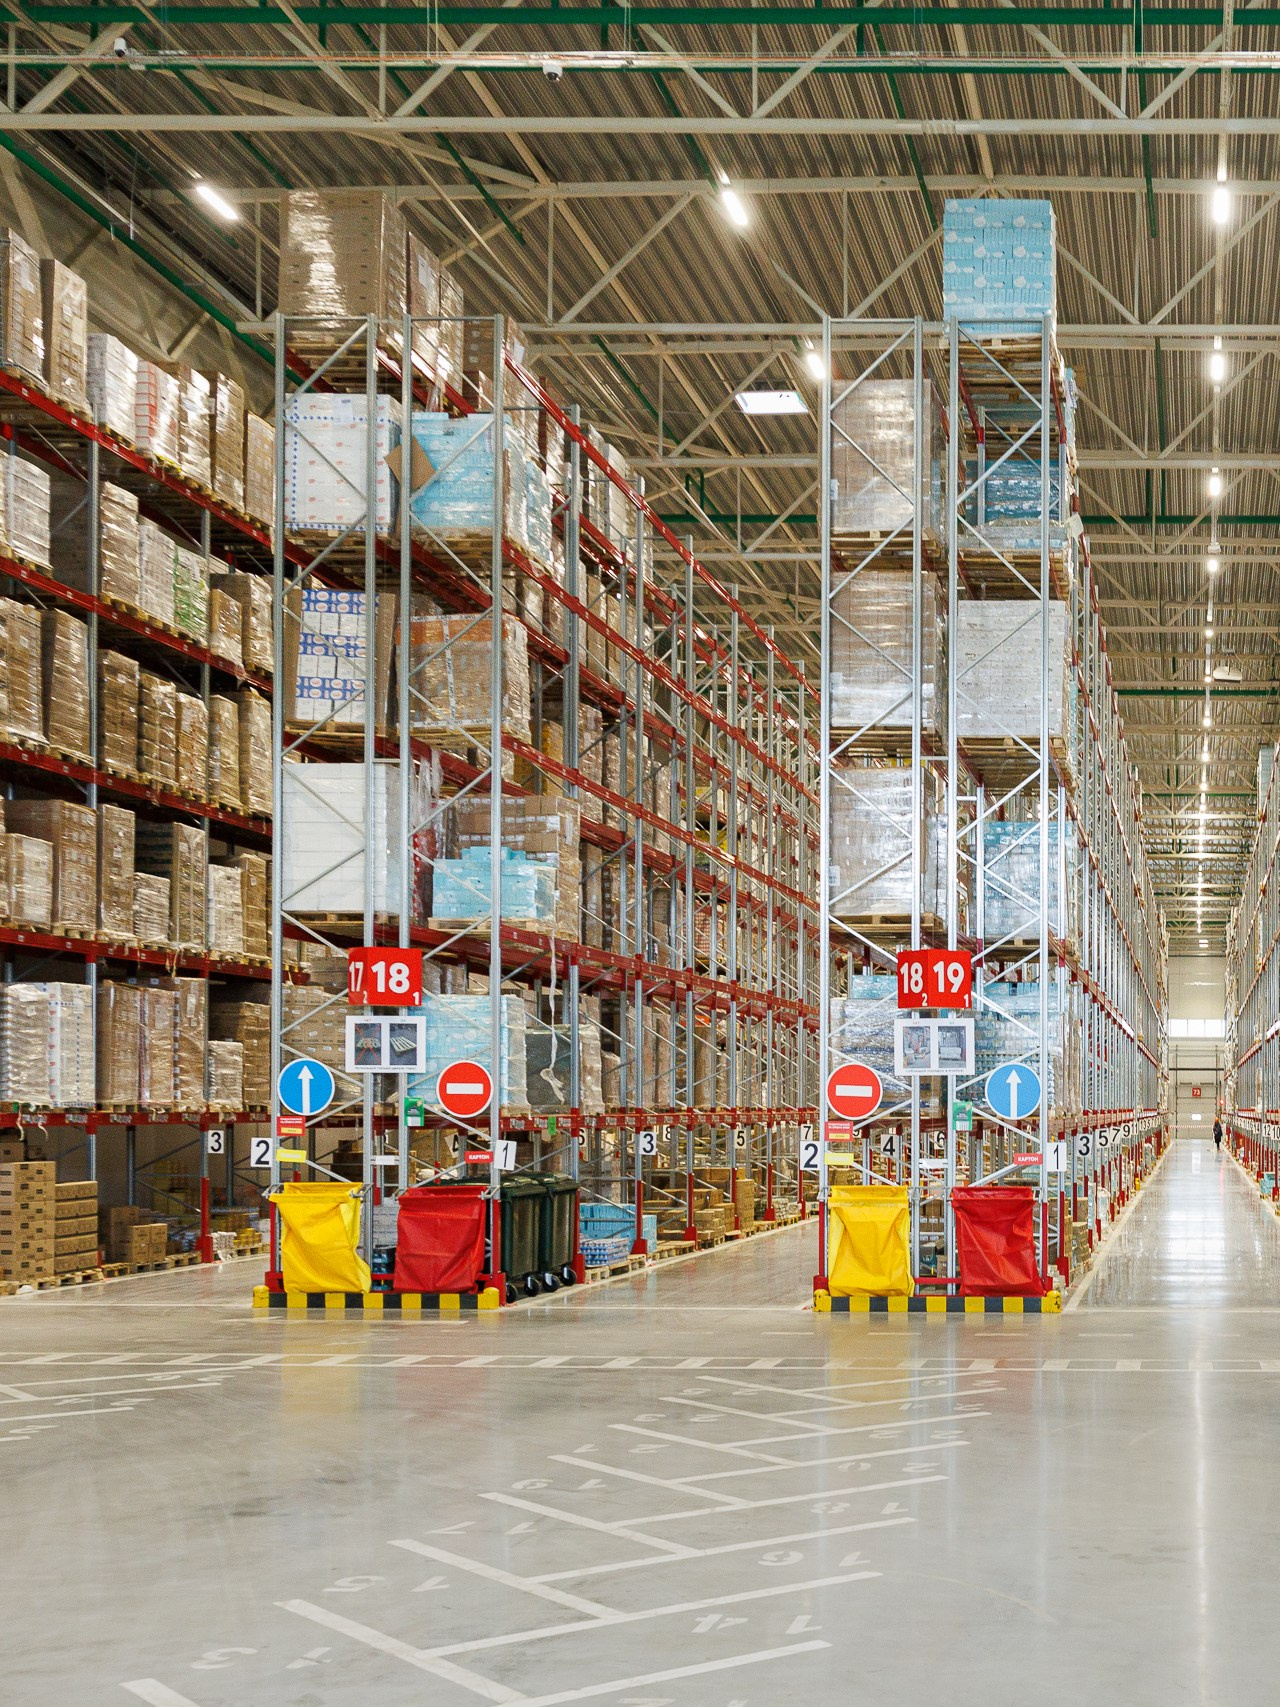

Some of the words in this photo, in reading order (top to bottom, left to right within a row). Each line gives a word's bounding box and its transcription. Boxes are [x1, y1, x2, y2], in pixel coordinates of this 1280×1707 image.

[349, 961, 364, 992] 17
[371, 961, 410, 994] 18
[900, 962, 924, 994] 18
[932, 961, 964, 993] 19
[413, 992, 420, 1005] 1
[922, 993, 928, 1006] 2
[964, 994, 969, 1007] 1
[736, 1130, 745, 1146] 5
[803, 1126, 812, 1140] 7
[1099, 1130, 1108, 1146] 5
[1112, 1128, 1120, 1142] 7
[1123, 1126, 1130, 1137] 9
[1264, 1124, 1270, 1136] 12
[1273, 1125, 1280, 1138] 10
[210, 1132, 222, 1152] 3
[642, 1134, 654, 1154] 3
[883, 1136, 896, 1156] 4
[937, 1132, 945, 1148] 6
[1078, 1136, 1090, 1156] 3
[255, 1140, 270, 1165] 2
[502, 1142, 508, 1168] 1
[804, 1143, 818, 1168] 2
[1054, 1144, 1059, 1169] 1
[633, 1413, 725, 1422] 23
[868, 1429, 965, 1439] 22
[572, 1443, 670, 1454] 21
[837, 1461, 940, 1472] 20
[511, 1478, 607, 1490] 19
[809, 1501, 909, 1514] 18
[424, 1520, 538, 1536] 17
[757, 1550, 871, 1567] 16
[322, 1575, 450, 1593] 15
[691, 1613, 822, 1634] 14
[190, 1645, 332, 1670] 13
